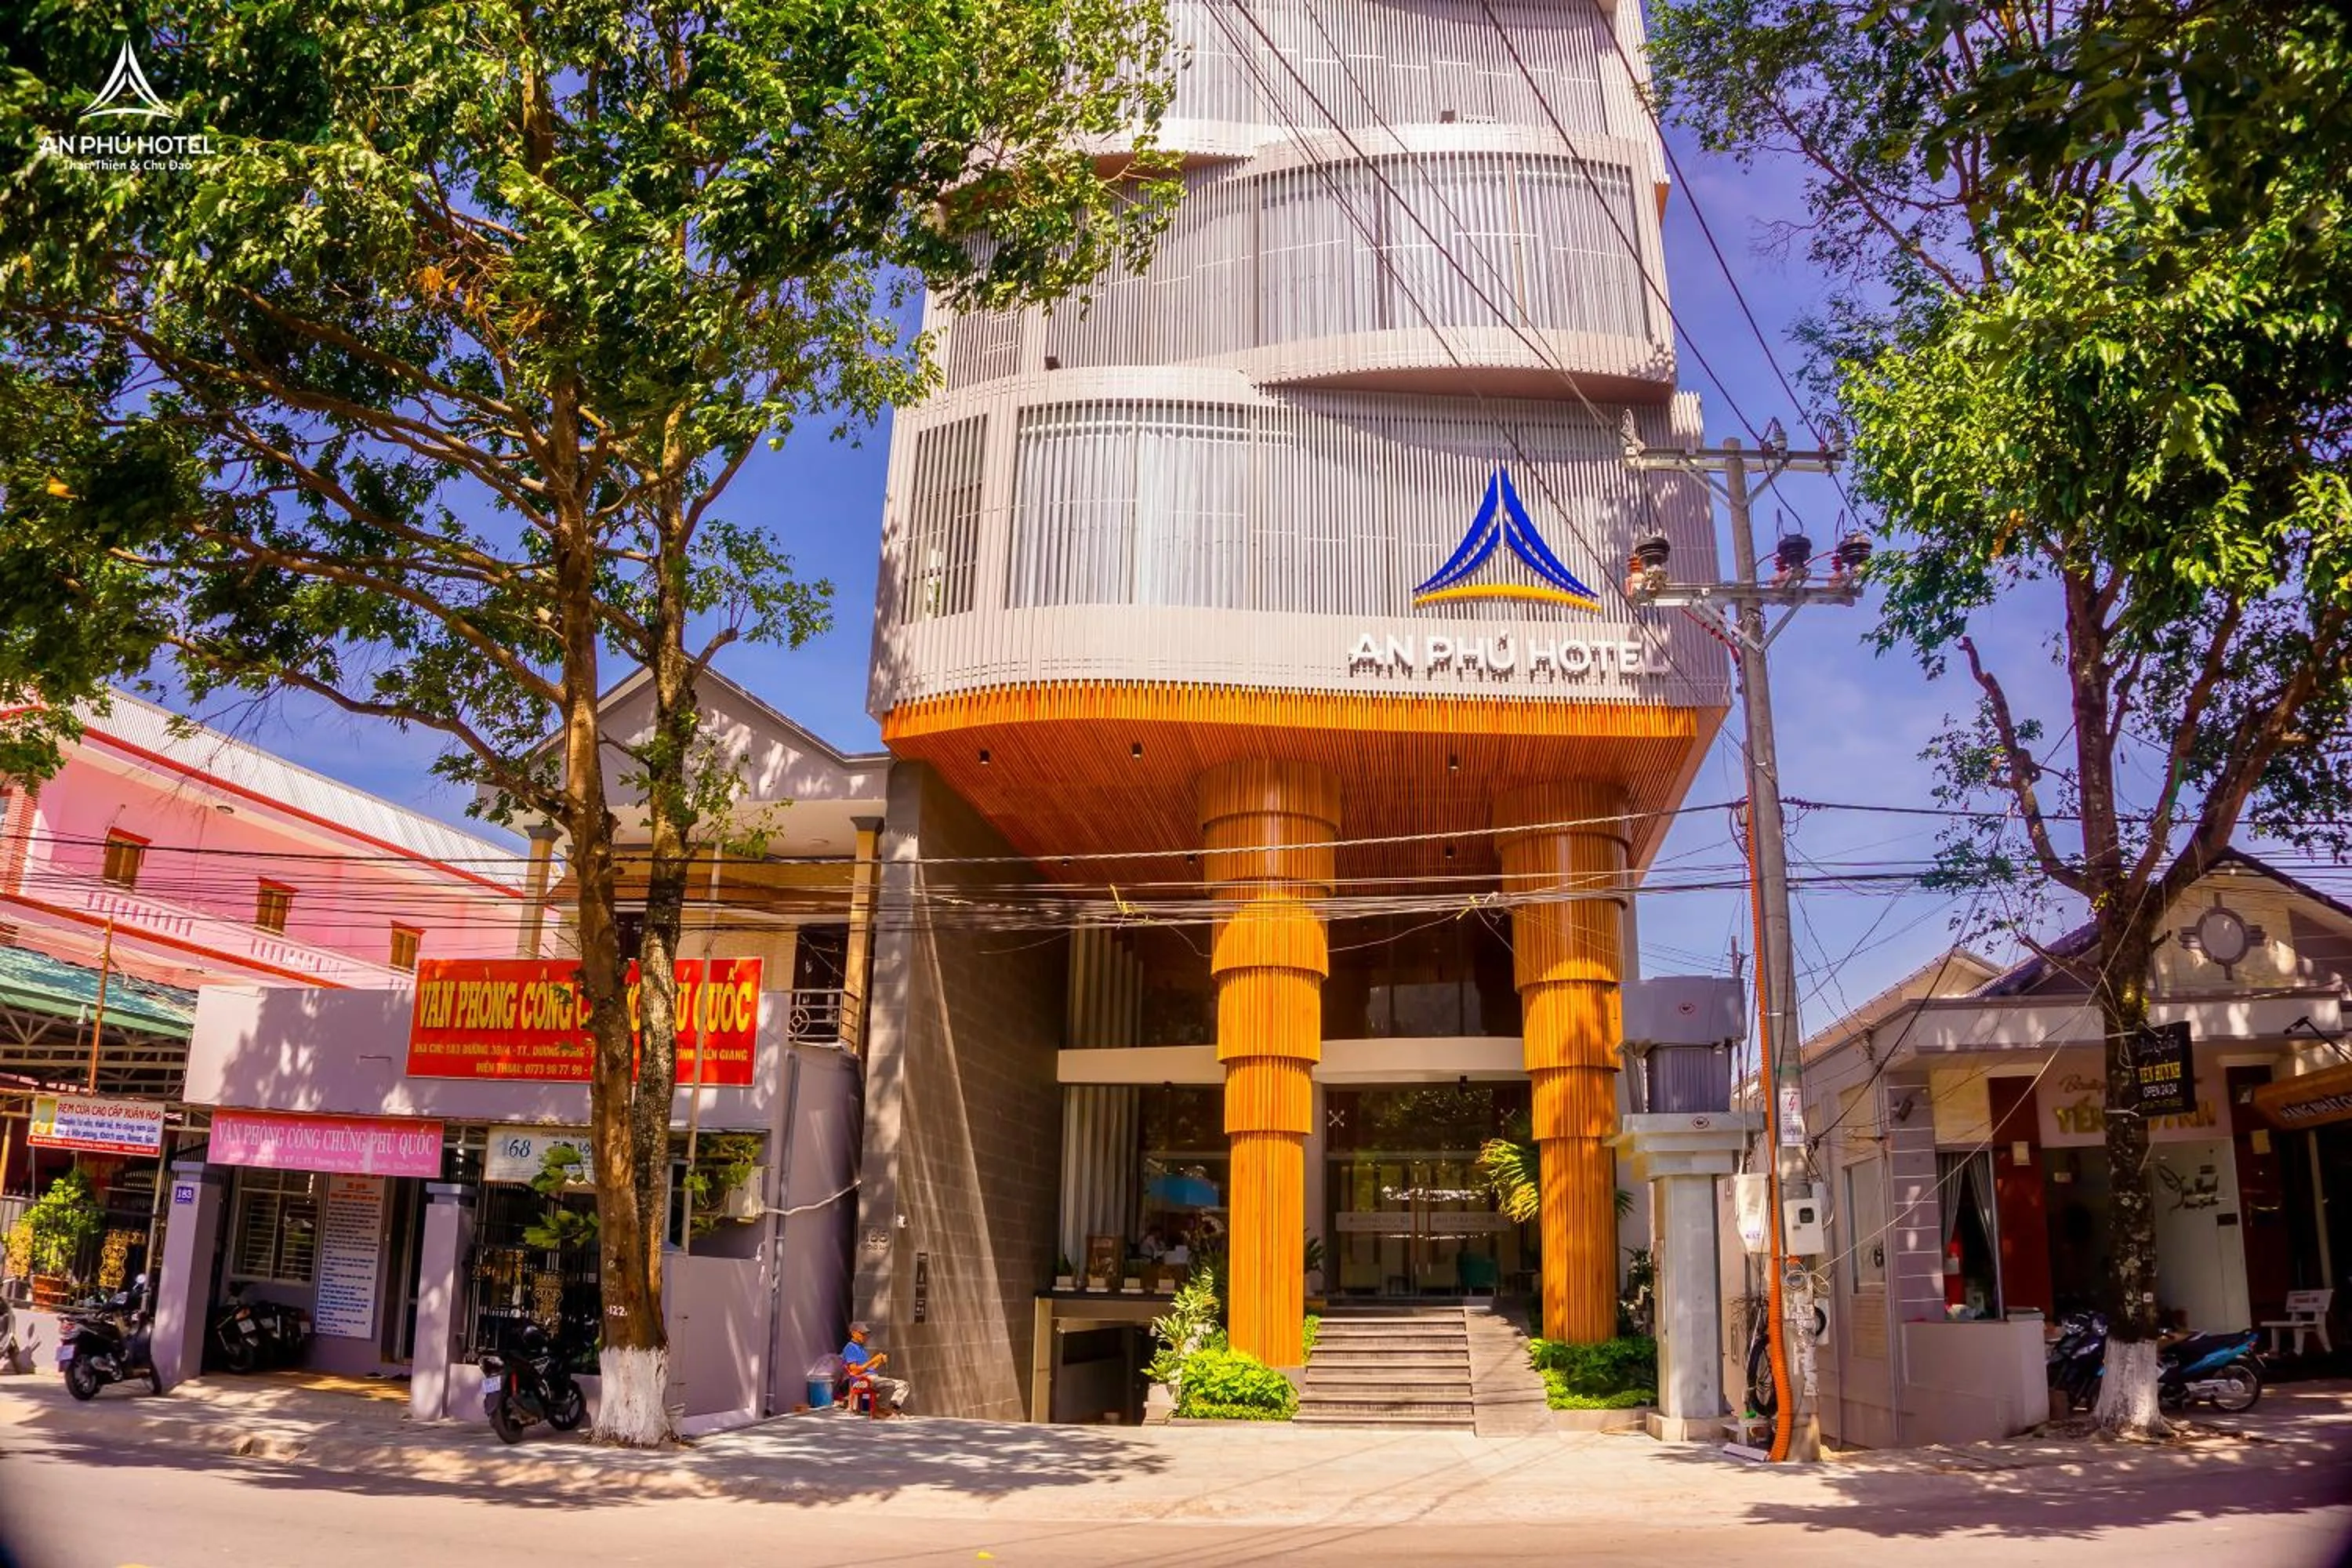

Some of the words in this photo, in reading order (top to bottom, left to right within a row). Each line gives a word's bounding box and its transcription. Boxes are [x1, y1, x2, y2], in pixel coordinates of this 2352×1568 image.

[1348, 633, 1414, 672] AN
[1428, 630, 1515, 672] PHÚ
[1530, 639, 1671, 674] HOTEL
[455, 967, 518, 1029] PHÒNG
[521, 967, 575, 1031] CÔNG
[2143, 1086, 2160, 1098] OPEN
[509, 1139, 531, 1158] 68
